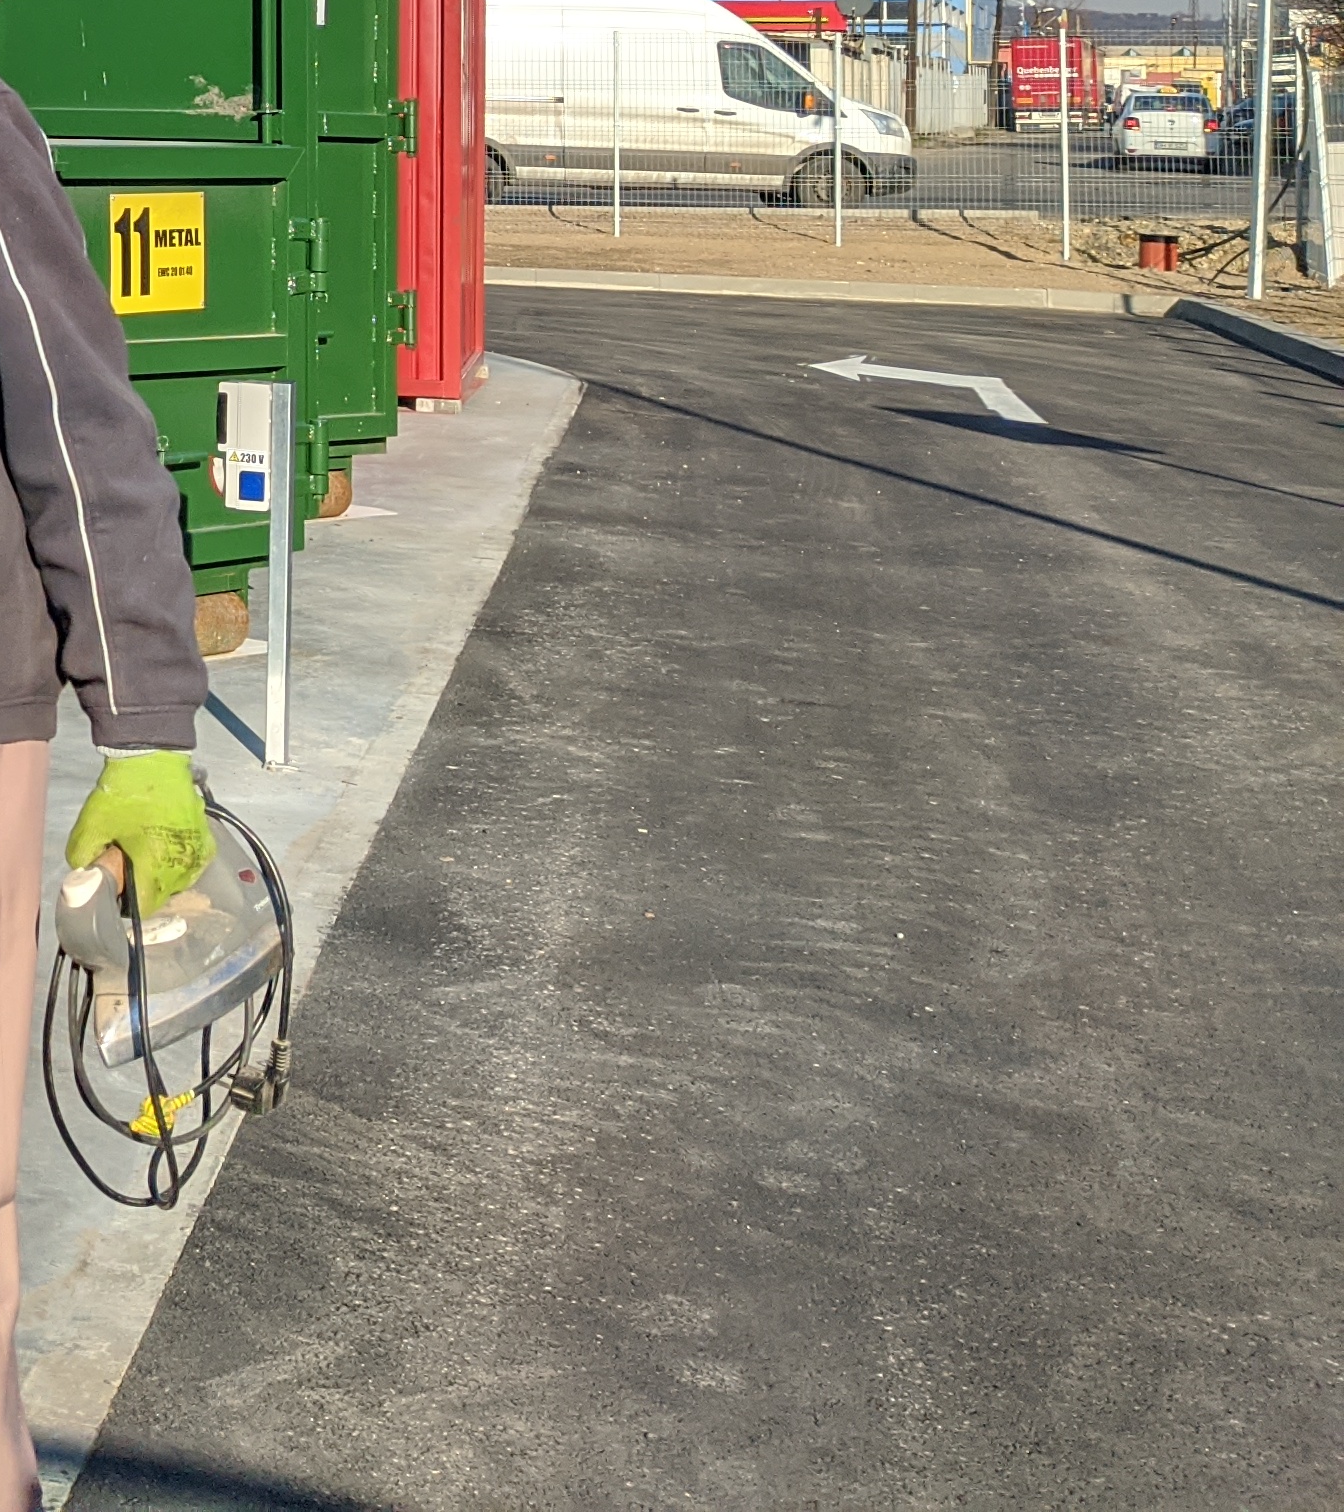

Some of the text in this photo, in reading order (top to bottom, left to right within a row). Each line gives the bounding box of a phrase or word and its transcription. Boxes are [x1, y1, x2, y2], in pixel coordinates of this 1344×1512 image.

[154, 227, 201, 248] METAL
[114, 207, 151, 297] 11
[240, 452, 265, 465] 230 V
